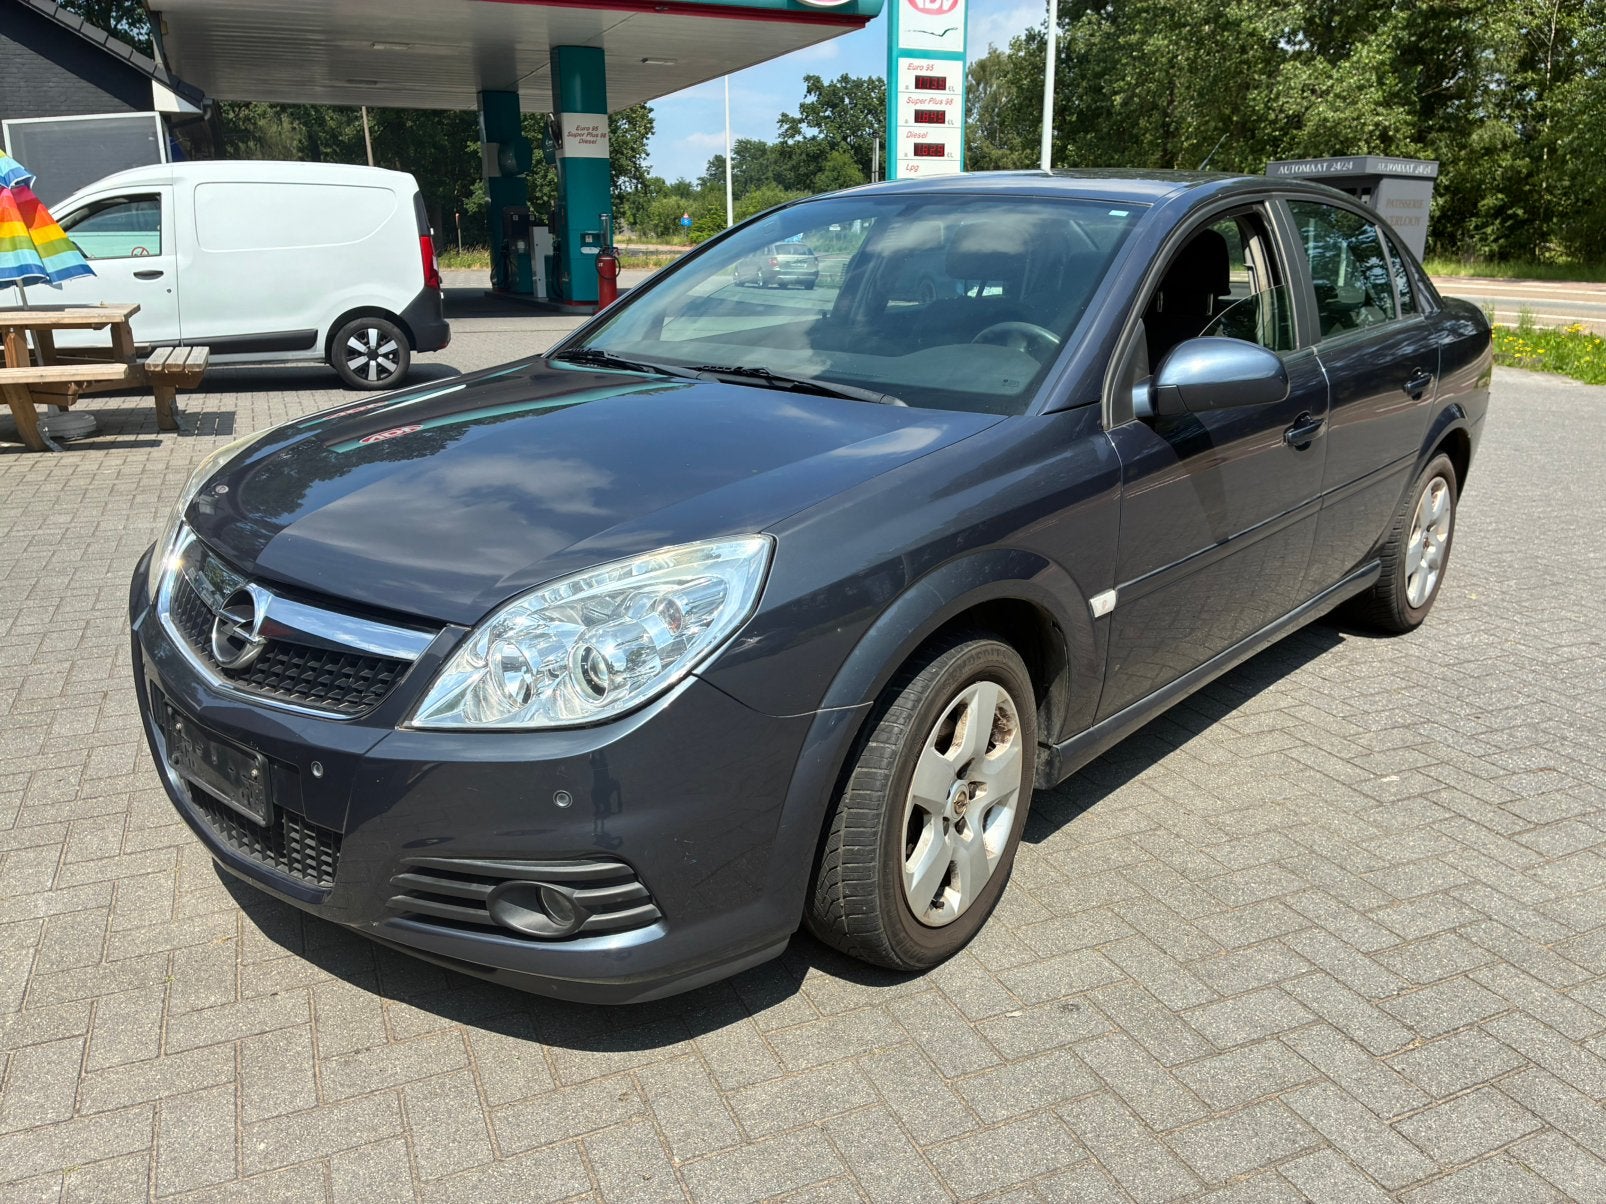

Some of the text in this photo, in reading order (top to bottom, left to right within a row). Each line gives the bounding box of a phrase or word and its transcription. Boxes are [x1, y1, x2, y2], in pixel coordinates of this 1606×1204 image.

[907, 62, 925, 71] Euro
[906, 96, 927, 106] Super
[928, 97, 944, 105] Plus
[906, 164, 919, 172] Lpg
[1278, 161, 1354, 174] AUTOMAAT 24/24
